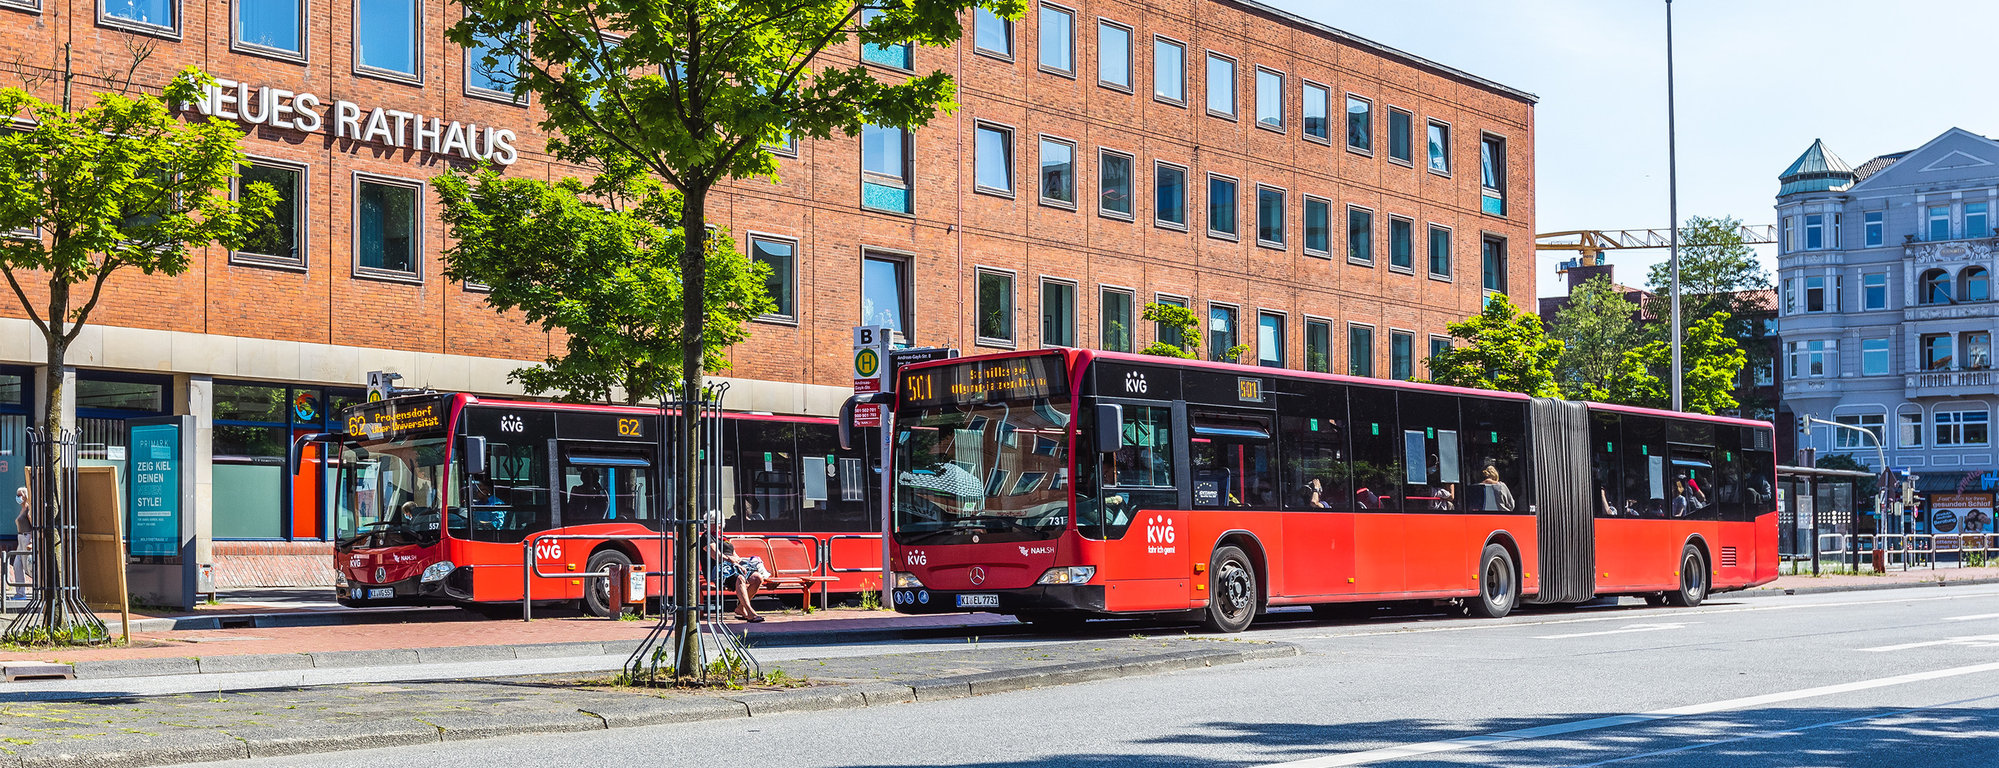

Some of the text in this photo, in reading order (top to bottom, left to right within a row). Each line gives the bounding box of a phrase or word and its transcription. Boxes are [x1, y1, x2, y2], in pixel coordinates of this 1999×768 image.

[180, 78, 517, 165] NEUES RATHAUS
[860, 329, 873, 344] B
[371, 374, 379, 386] A
[908, 374, 932, 401] 501
[1125, 378, 1147, 393] KVG
[1240, 380, 1257, 398] 501
[348, 416, 367, 436] 62
[392, 416, 439, 431] Universität
[501, 420, 524, 432] KVG
[618, 418, 640, 436] 62
[137, 461, 171, 471] ZEIG KIEL
[137, 474, 164, 483] DEINEN
[137, 498, 162, 507] STYLE!
[1049, 516, 1064, 525] 731
[1147, 526, 1174, 544] KVG
[536, 544, 562, 560] KVG
[350, 560, 361, 568] KVG
[907, 555, 926, 566] KVG
[961, 595, 998, 605] KI EL 7731
